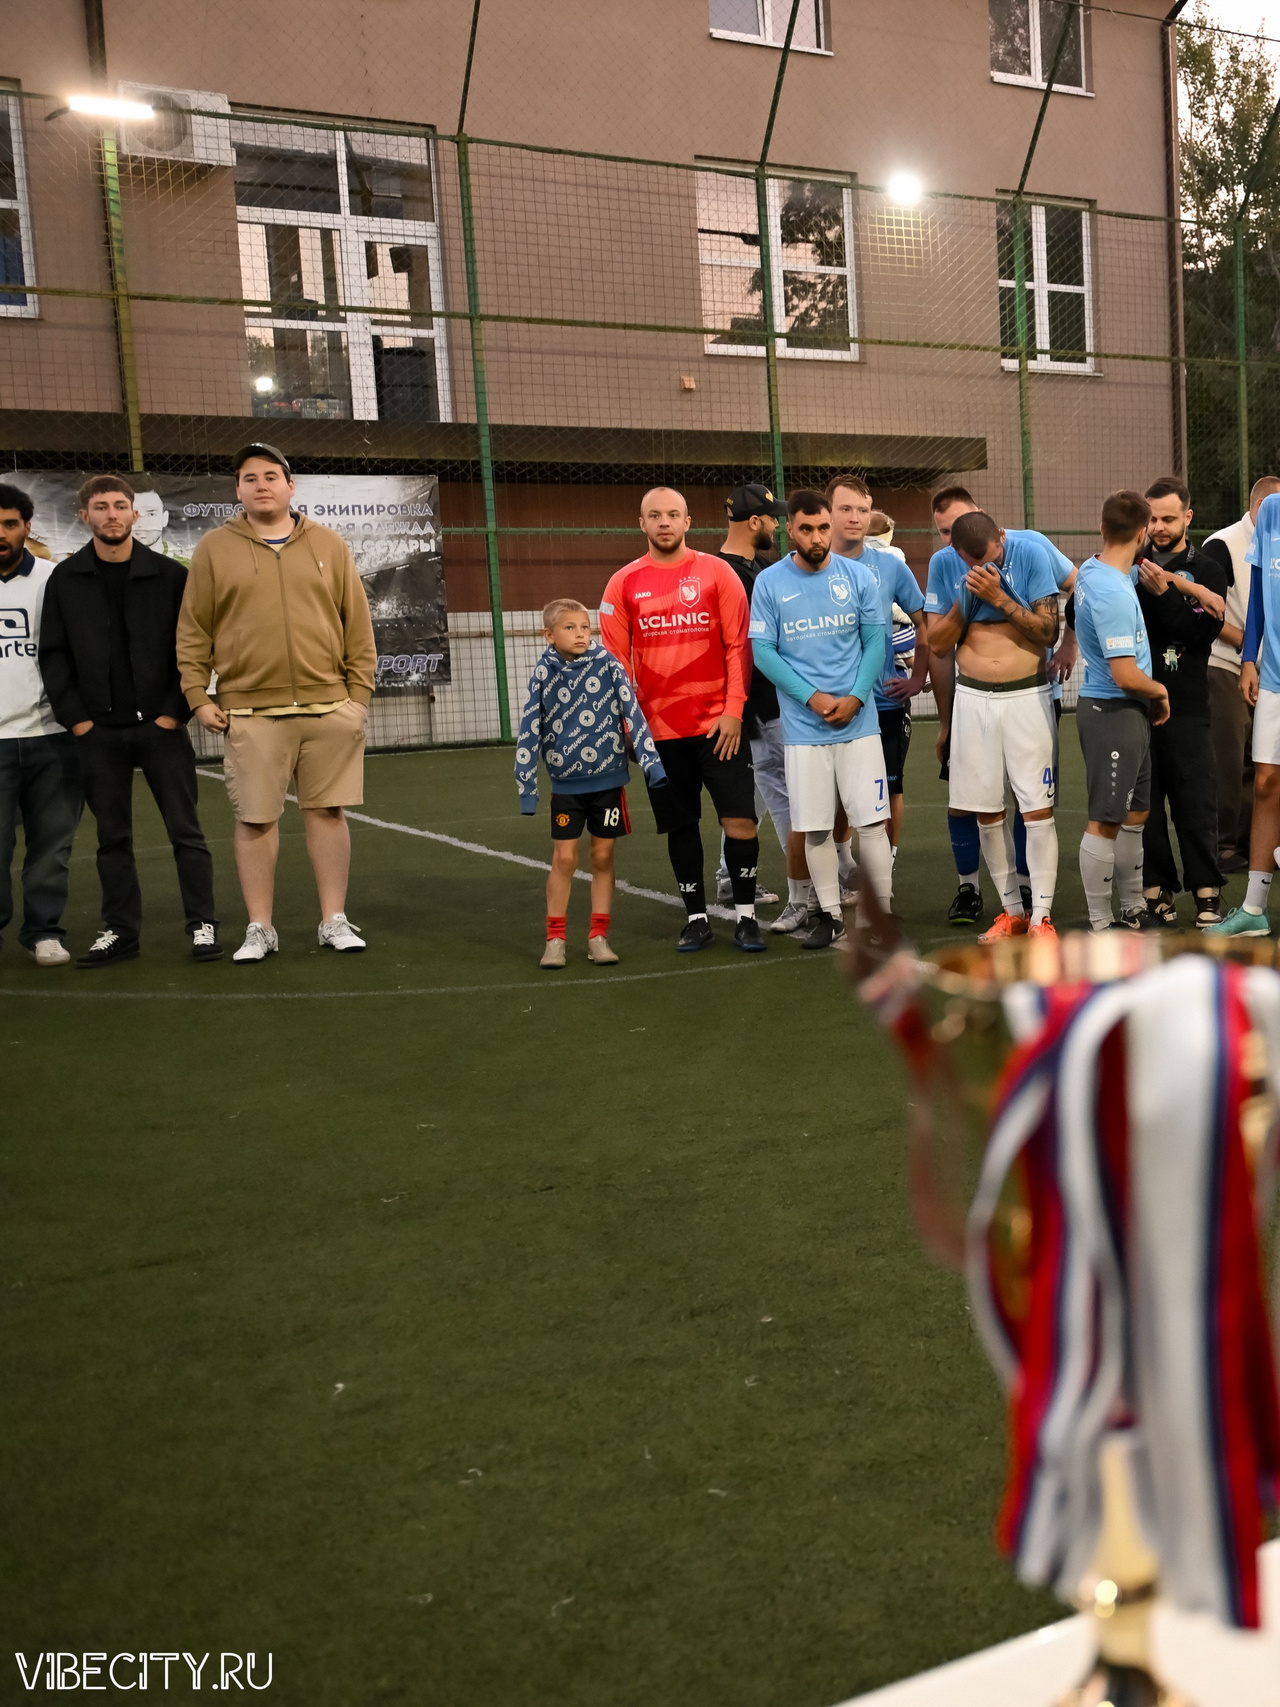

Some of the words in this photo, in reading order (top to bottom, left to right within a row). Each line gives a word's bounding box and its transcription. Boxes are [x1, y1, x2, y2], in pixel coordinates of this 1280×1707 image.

[314, 502, 434, 516] ЭКИПИРОВКА
[346, 539, 436, 552] ЕССУАРЫ
[635, 591, 651, 599] JAKO
[376, 654, 443, 673] PORT
[874, 778, 883, 800] 7
[603, 807, 620, 827] 18
